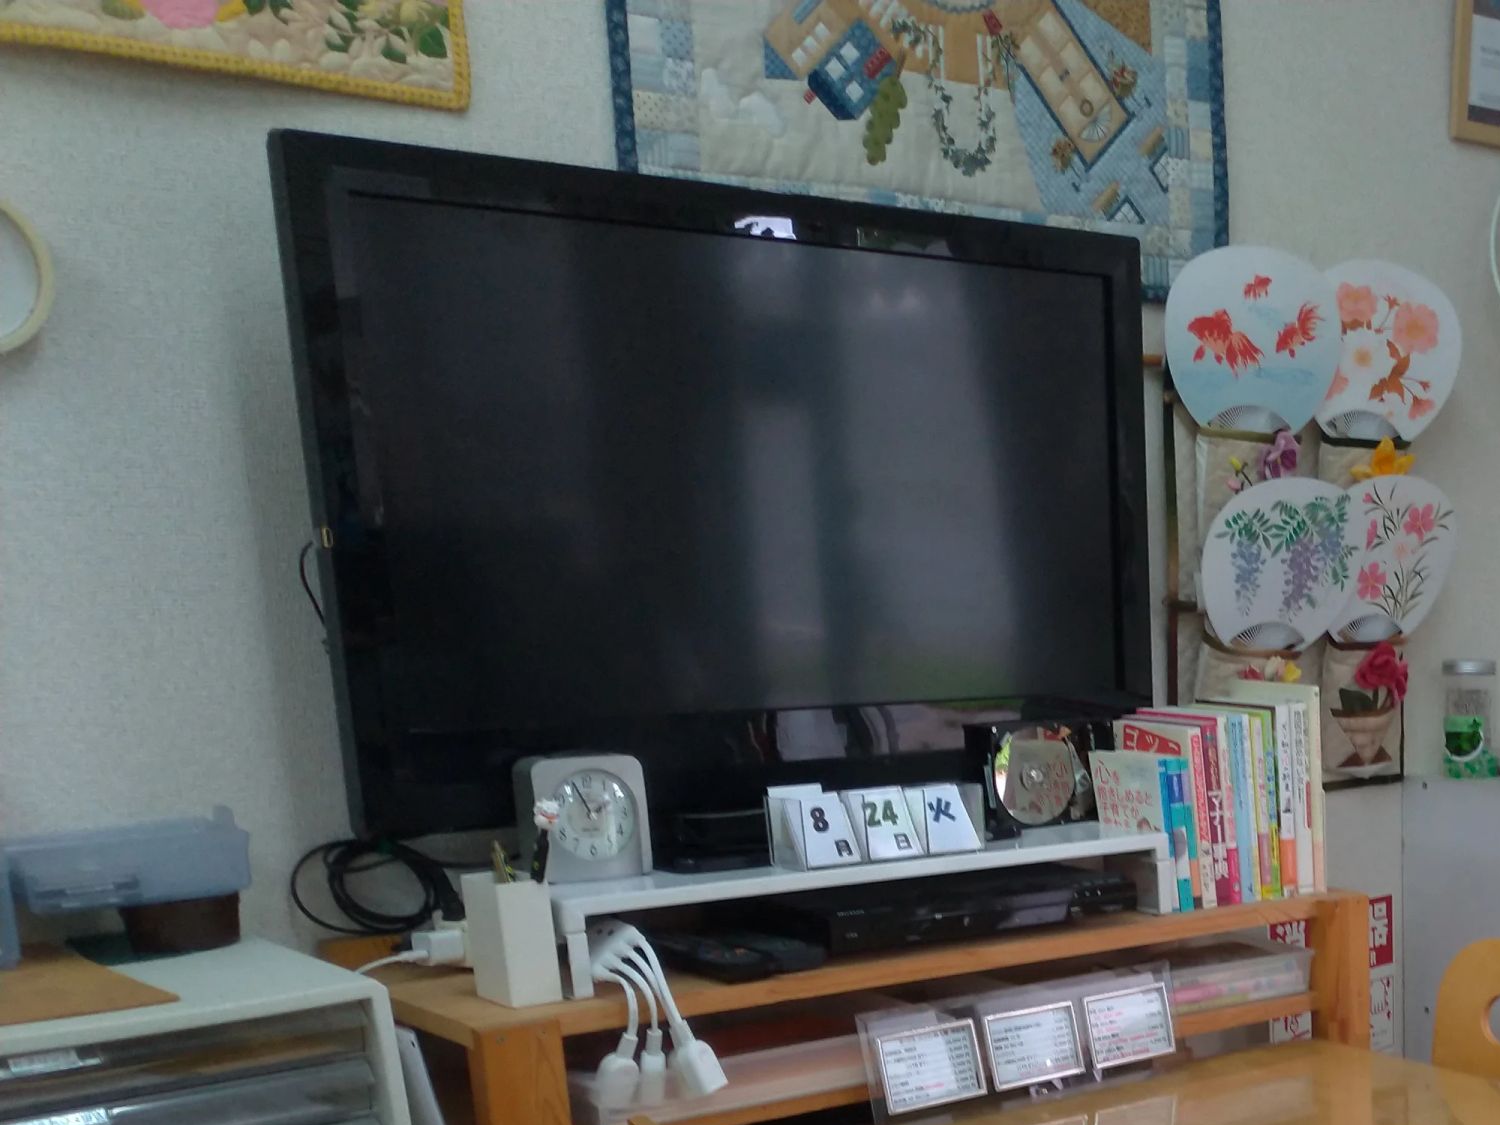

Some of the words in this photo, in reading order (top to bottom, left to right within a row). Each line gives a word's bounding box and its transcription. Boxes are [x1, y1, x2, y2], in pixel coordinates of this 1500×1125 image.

[810, 807, 830, 833] 8
[835, 839, 853, 857] 月
[863, 799, 898, 828] 24
